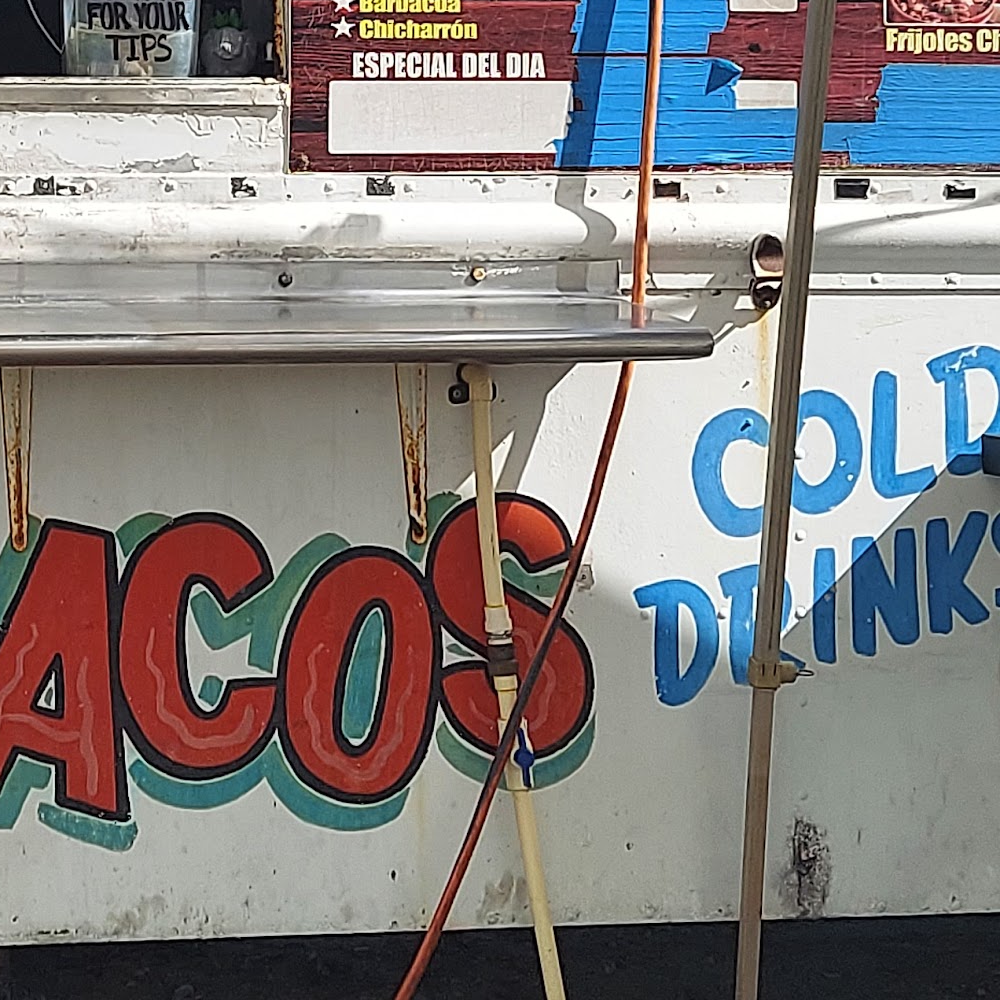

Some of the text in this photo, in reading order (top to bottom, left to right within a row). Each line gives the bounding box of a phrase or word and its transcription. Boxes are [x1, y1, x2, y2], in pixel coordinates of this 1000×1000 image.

[87, 1, 190, 31] FOR YOUR
[359, 19, 478, 40] Chicharrón
[105, 34, 173, 62] TIPS
[885, 28, 972, 53] Frijoles
[352, 52, 546, 78] ESPECIAL DEL DIA
[692, 346, 1000, 537] COLD
[633, 510, 1000, 706] DRINK
